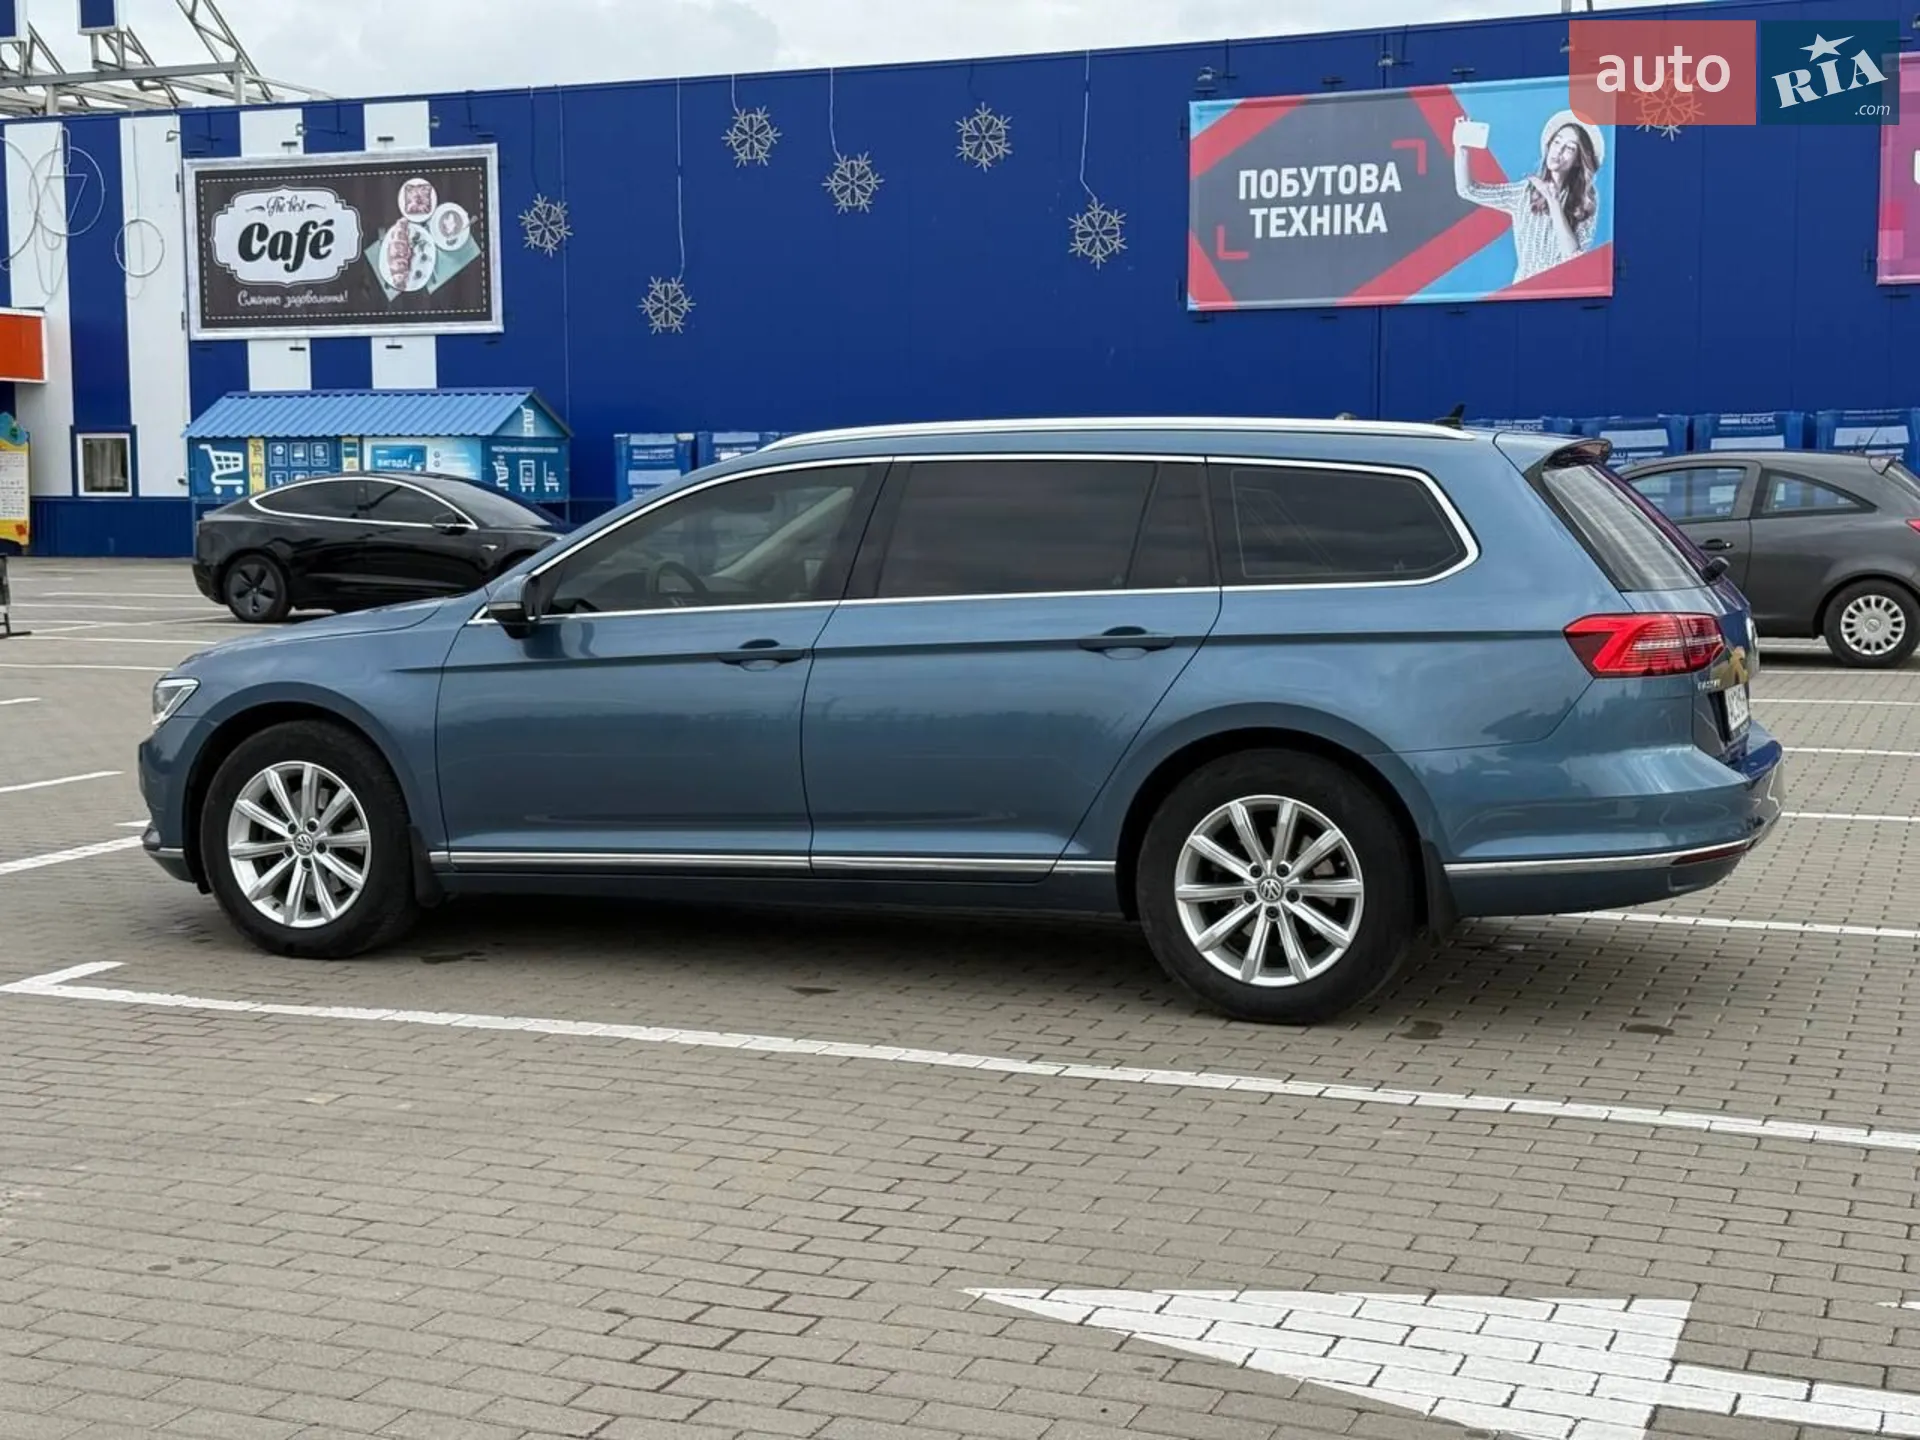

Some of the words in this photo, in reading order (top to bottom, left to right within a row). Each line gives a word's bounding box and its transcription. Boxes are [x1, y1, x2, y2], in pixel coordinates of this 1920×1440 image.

[1238, 161, 1403, 200] ПОБУТОВА
[266, 195, 286, 217] The
[1249, 202, 1389, 239] ТЕХНІКА
[238, 218, 335, 273] Café
[1741, 416, 1775, 425] BLOCK
